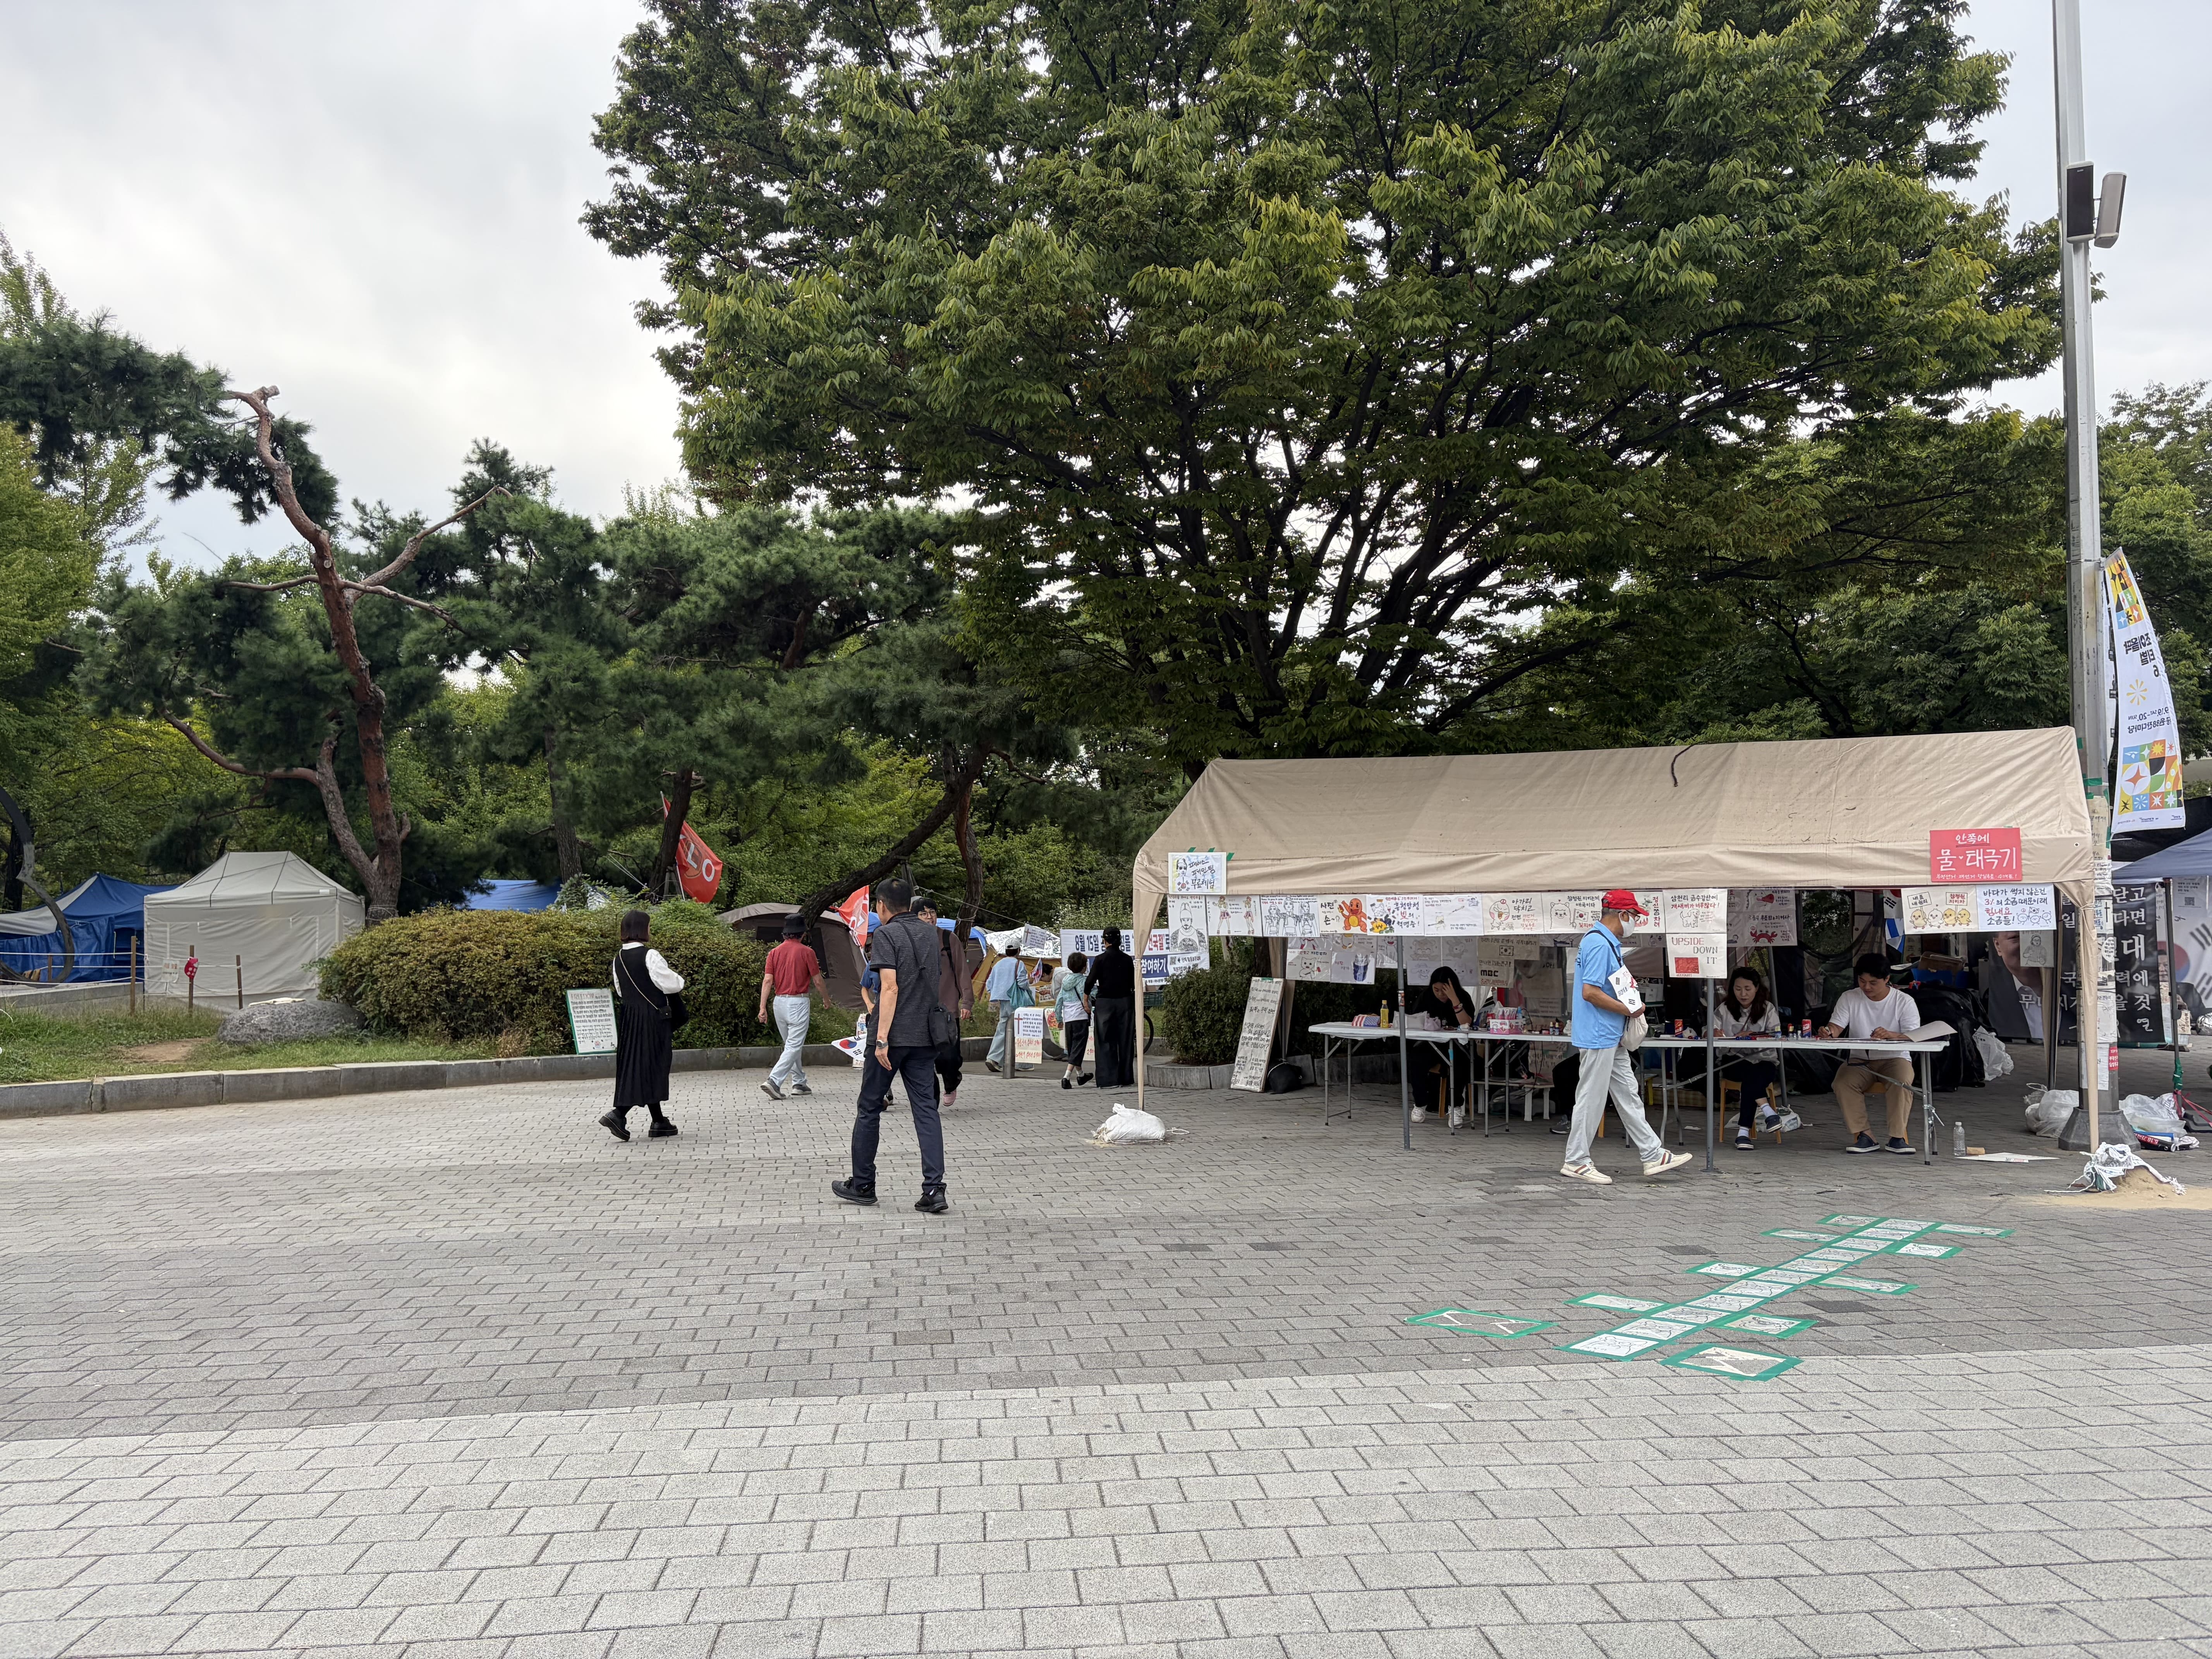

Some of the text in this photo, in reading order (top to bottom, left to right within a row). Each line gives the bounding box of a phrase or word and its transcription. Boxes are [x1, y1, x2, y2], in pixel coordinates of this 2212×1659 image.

[1956, 833, 1989, 844] 안쪽에
[1936, 847, 2016, 871] 물 태극기
[1192, 865, 1216, 876] 페인팅
[1191, 879, 1215, 890] 무료체험
[1983, 888, 2047, 897] 바다가 썩지 않는건
[2113, 887, 2146, 903] 닫고
[1394, 902, 1419, 911] 흥청망청
[1514, 905, 1535, 914] 닥치고
[1985, 907, 2012, 916] 힘내요
[1987, 916, 2015, 926] 소금들!
[1075, 934, 1085, 952] 8월
[1087, 935, 1099, 952] 15일
[1671, 937, 1704, 945] UPSIDE
[2121, 934, 2145, 961] 대
[1141, 958, 1166, 974] 참여하기
[2135, 994, 2151, 1011] 것
